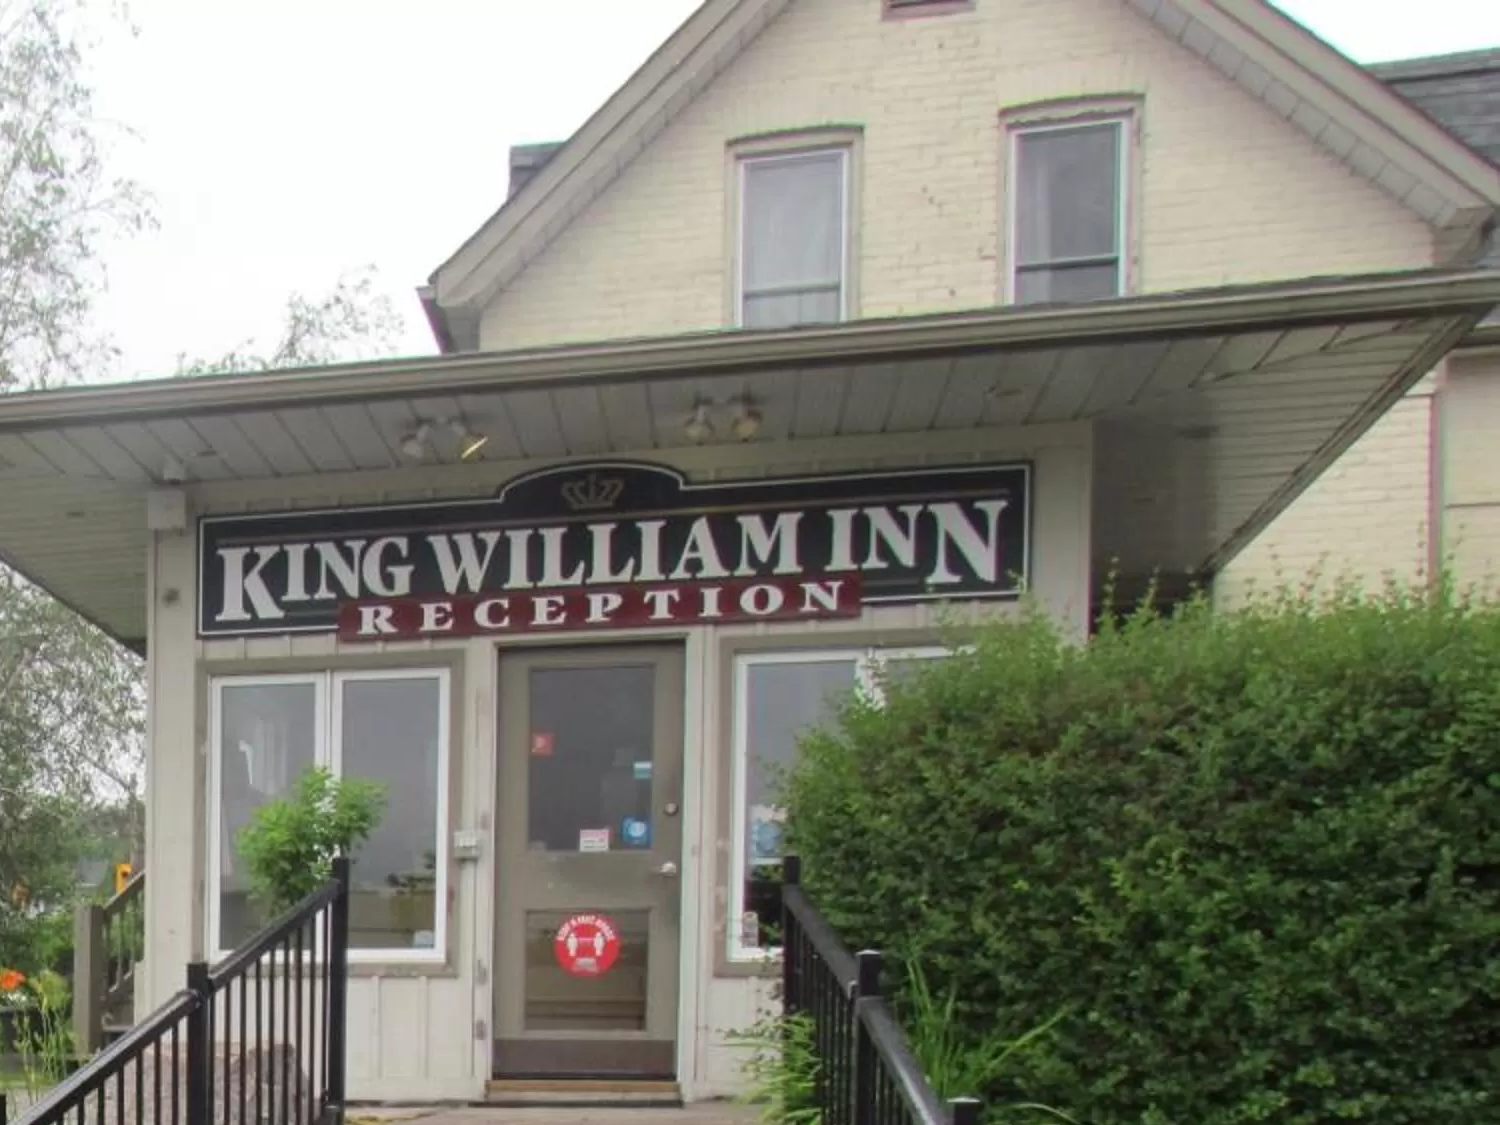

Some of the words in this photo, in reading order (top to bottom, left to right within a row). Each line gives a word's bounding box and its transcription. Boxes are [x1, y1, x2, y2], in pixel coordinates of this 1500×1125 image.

[214, 535, 415, 622] KING
[426, 511, 805, 595] WILLIAM
[823, 500, 1009, 584] INN
[357, 579, 844, 636] RECEPTION
